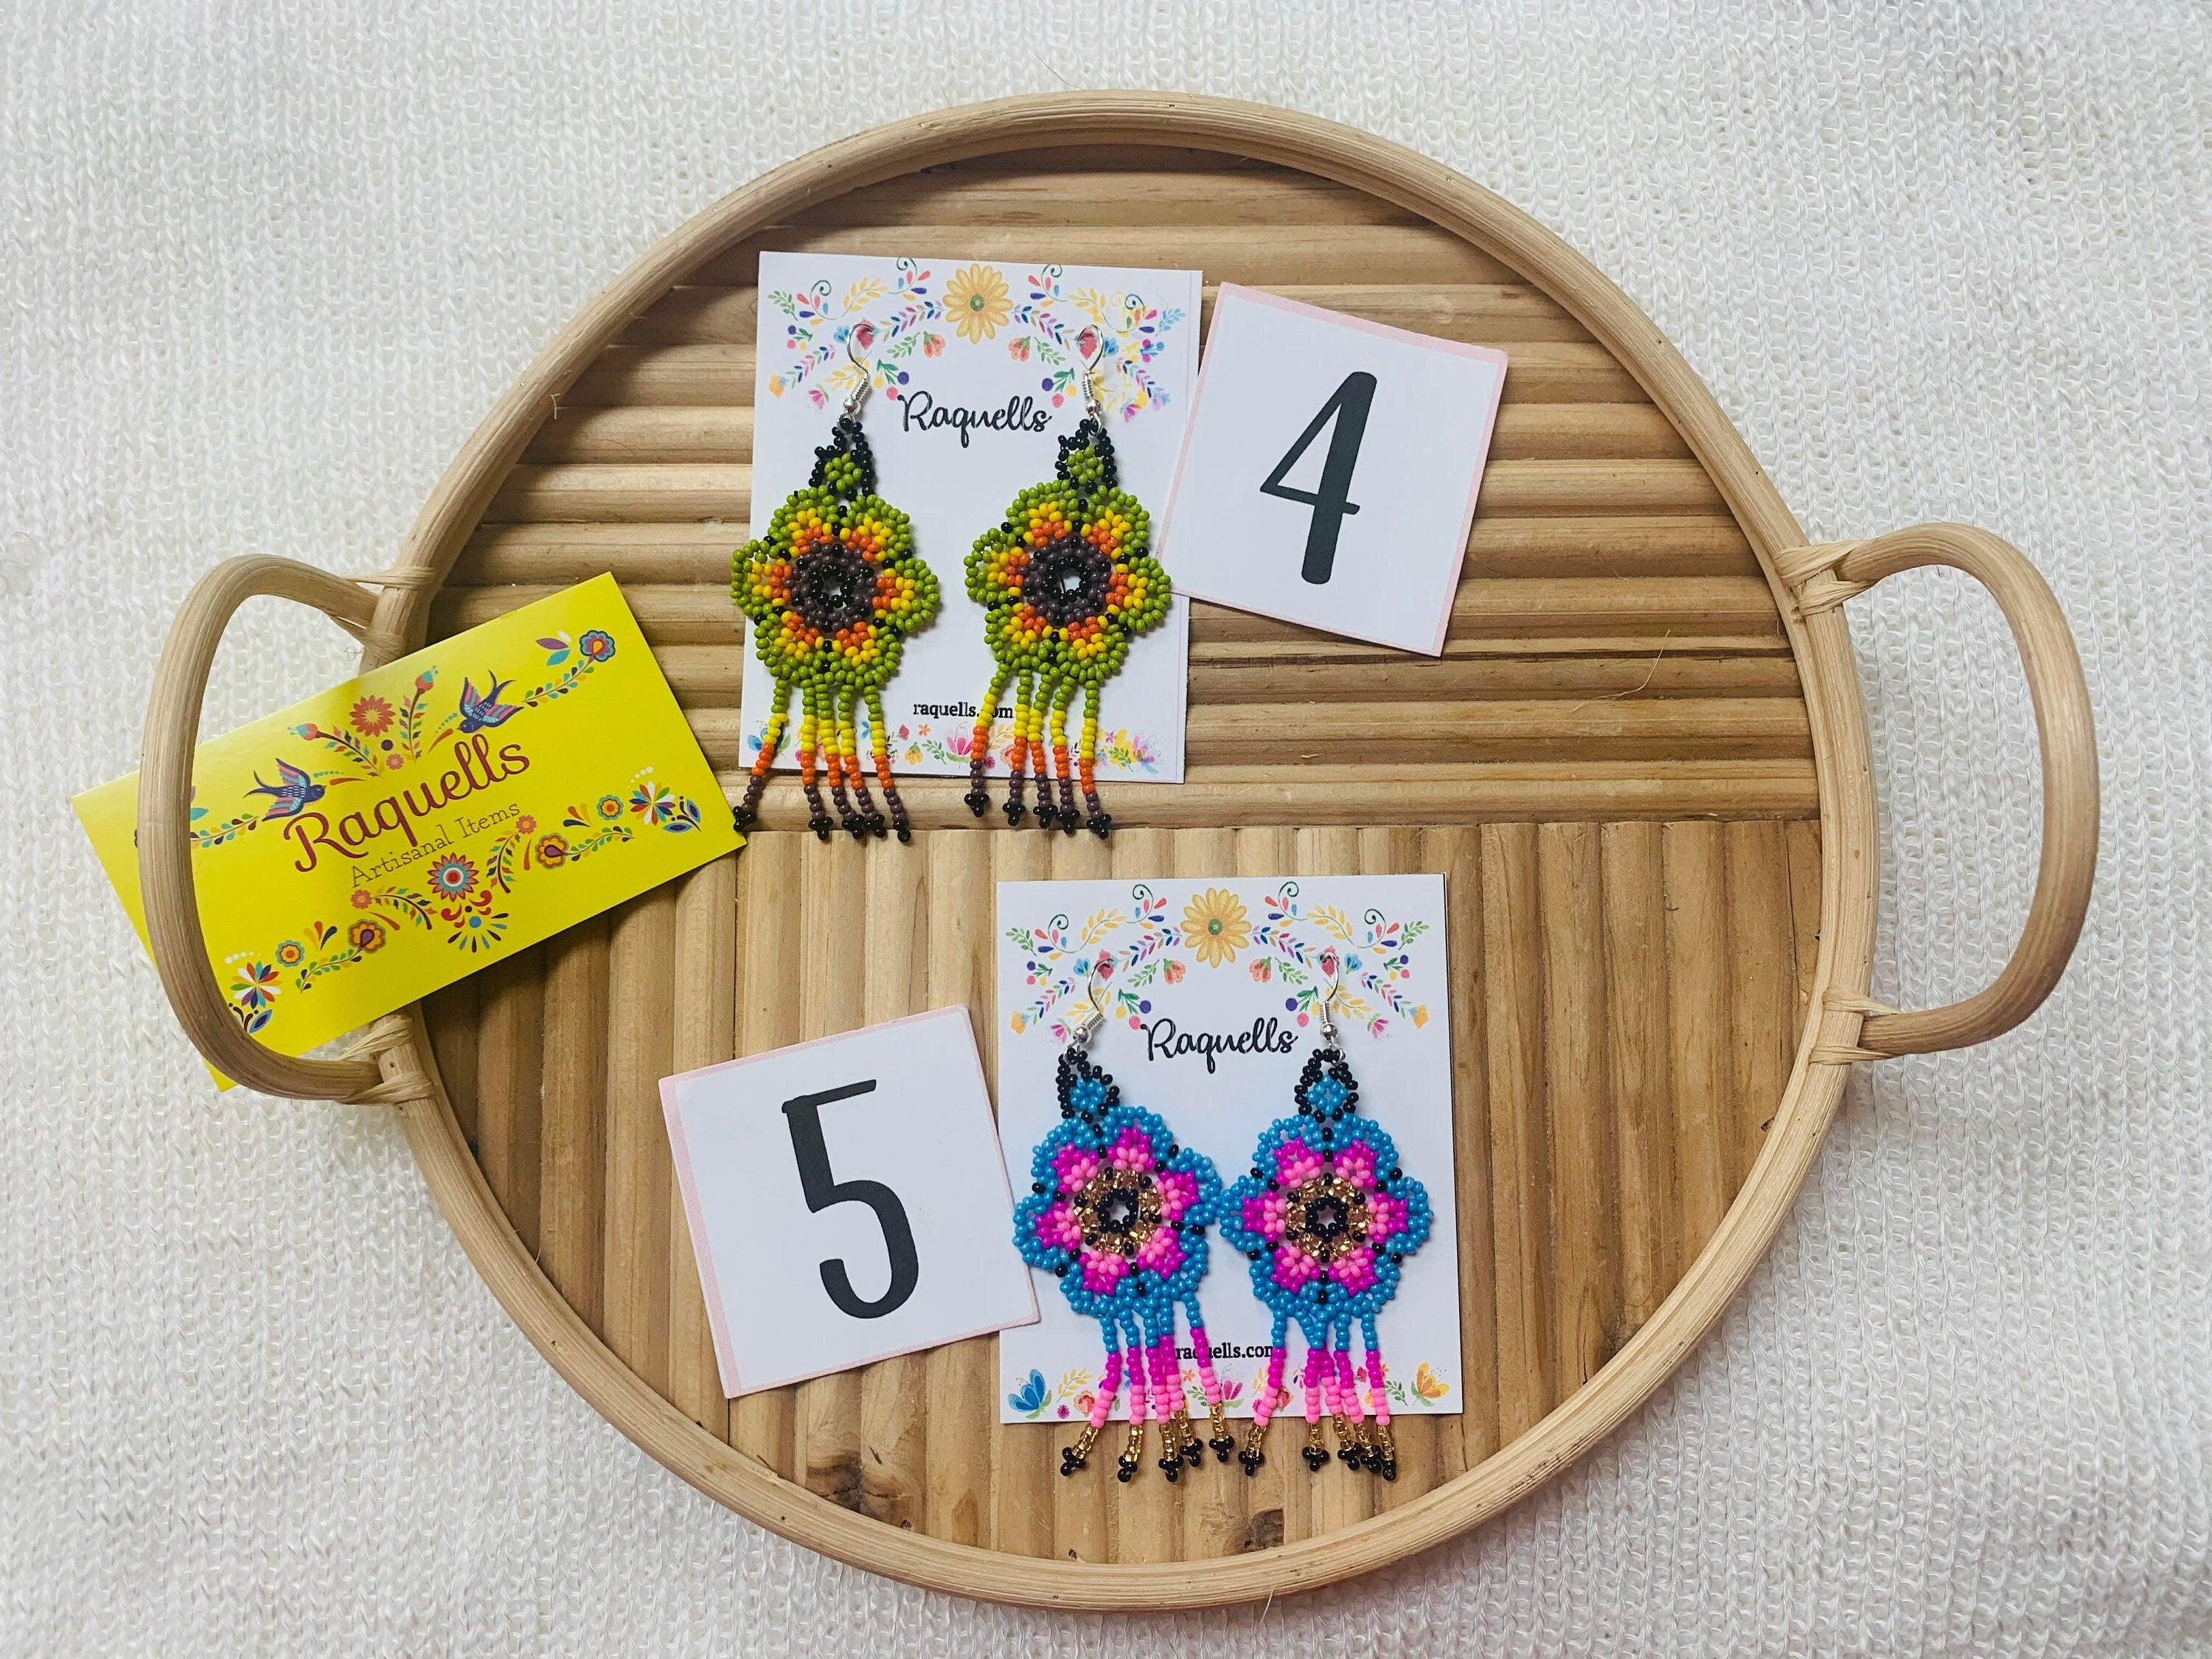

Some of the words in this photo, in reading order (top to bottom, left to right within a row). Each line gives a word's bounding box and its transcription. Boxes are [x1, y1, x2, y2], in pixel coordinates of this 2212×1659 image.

[897, 390, 1053, 448] Raquells
[1259, 371, 1377, 585] 4
[913, 701, 1014, 720] raquells.om
[283, 733, 530, 873] Raquells
[351, 824, 454, 888] Artisanal
[454, 803, 521, 839] Items
[1140, 1017, 1298, 1074] Raquells
[782, 1079, 919, 1319] 5
